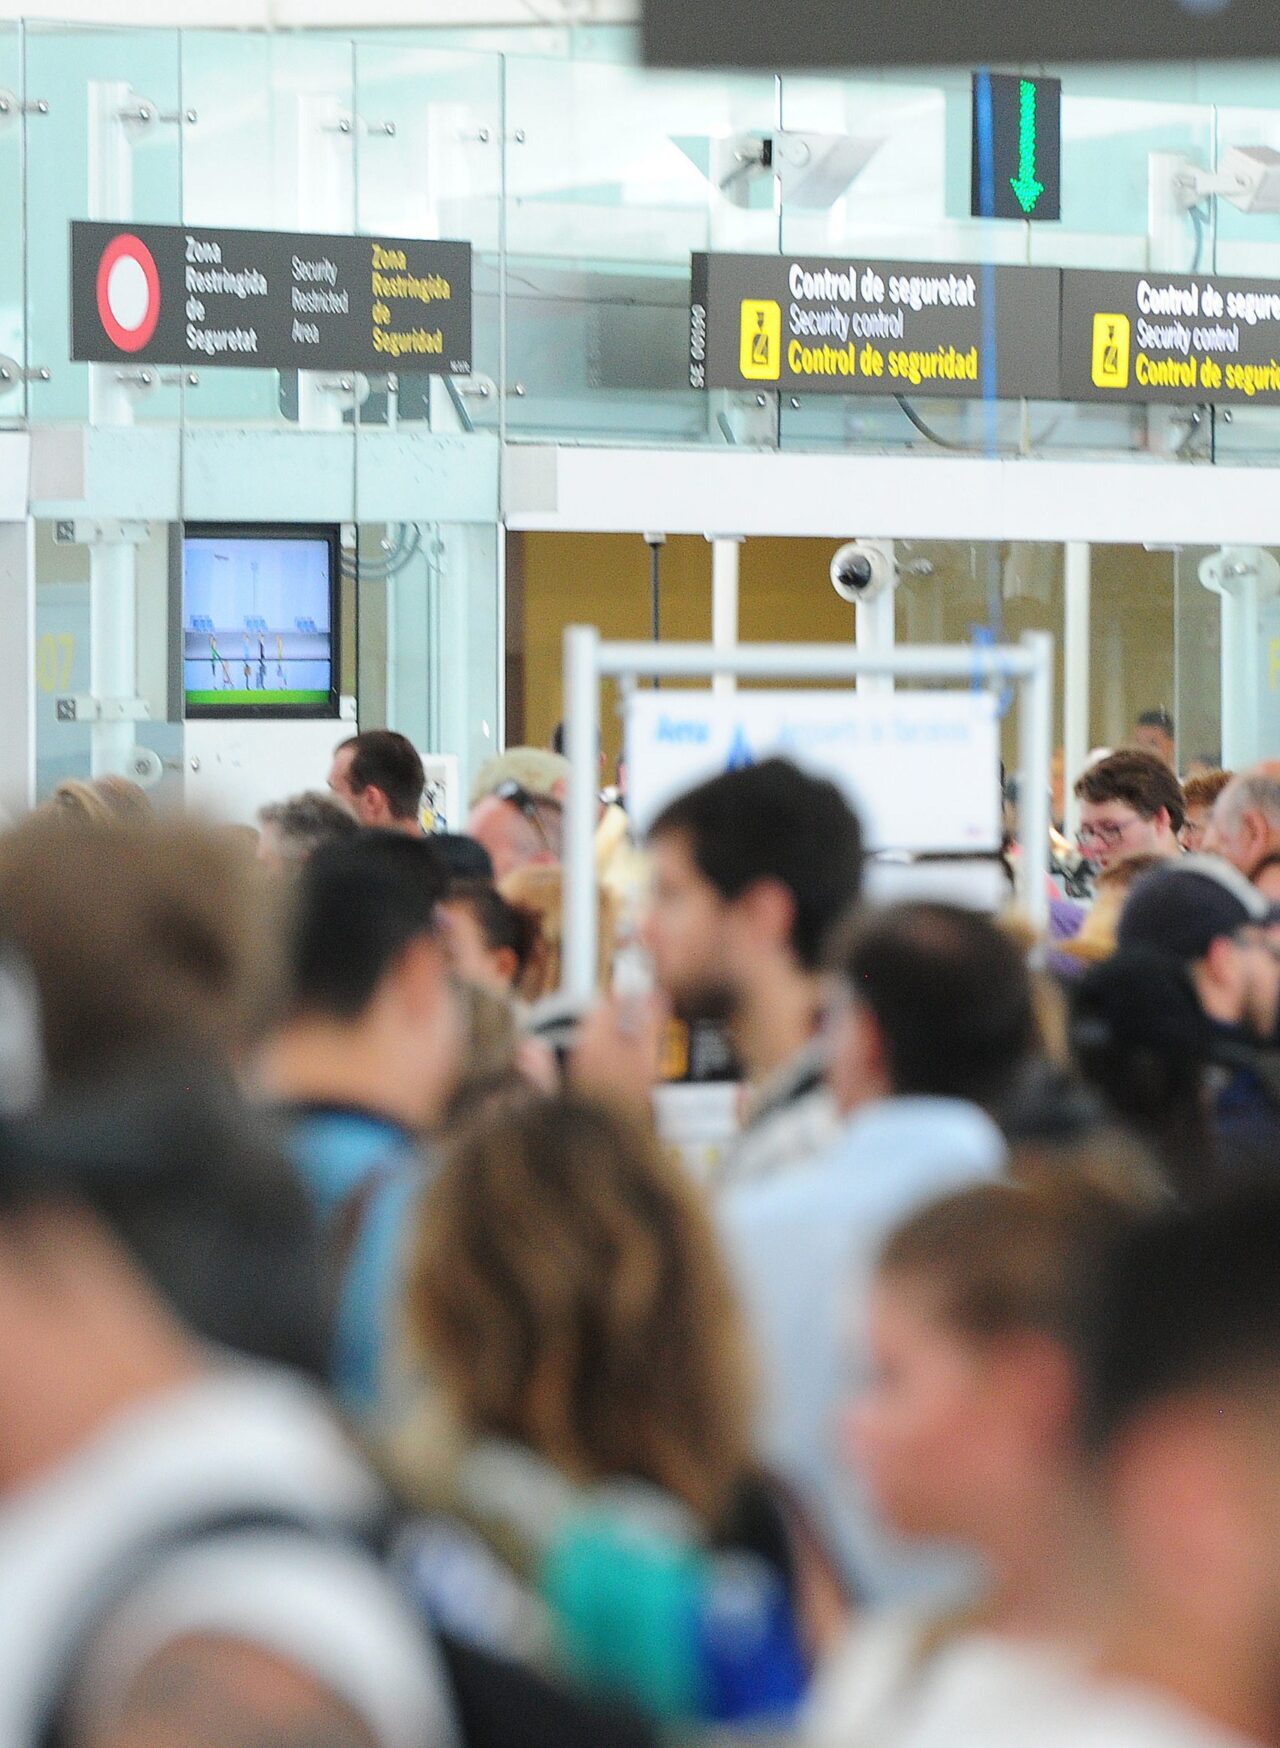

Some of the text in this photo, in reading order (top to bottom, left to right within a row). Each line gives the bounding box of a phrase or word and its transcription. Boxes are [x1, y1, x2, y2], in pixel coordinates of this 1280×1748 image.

[185, 235, 221, 264] Zona
[371, 242, 406, 270] Zona
[185, 265, 268, 299] Restringida
[291, 255, 337, 286] Security
[371, 270, 451, 304] Restringida
[788, 263, 976, 311] Control de seguretat
[185, 295, 206, 322] de
[291, 286, 349, 314] Restricted
[371, 299, 391, 325] de
[1136, 279, 1199, 316] Control
[1201, 283, 1225, 319] de
[186, 322, 258, 356] Seguretat
[291, 318, 320, 344] Area
[789, 302, 904, 343] Security control
[1136, 317, 1239, 355] Security control
[371, 326, 443, 358] Seguridad
[788, 340, 978, 385] Control de seguridad
[1135, 352, 1197, 387] Control
[1200, 354, 1222, 389] de
